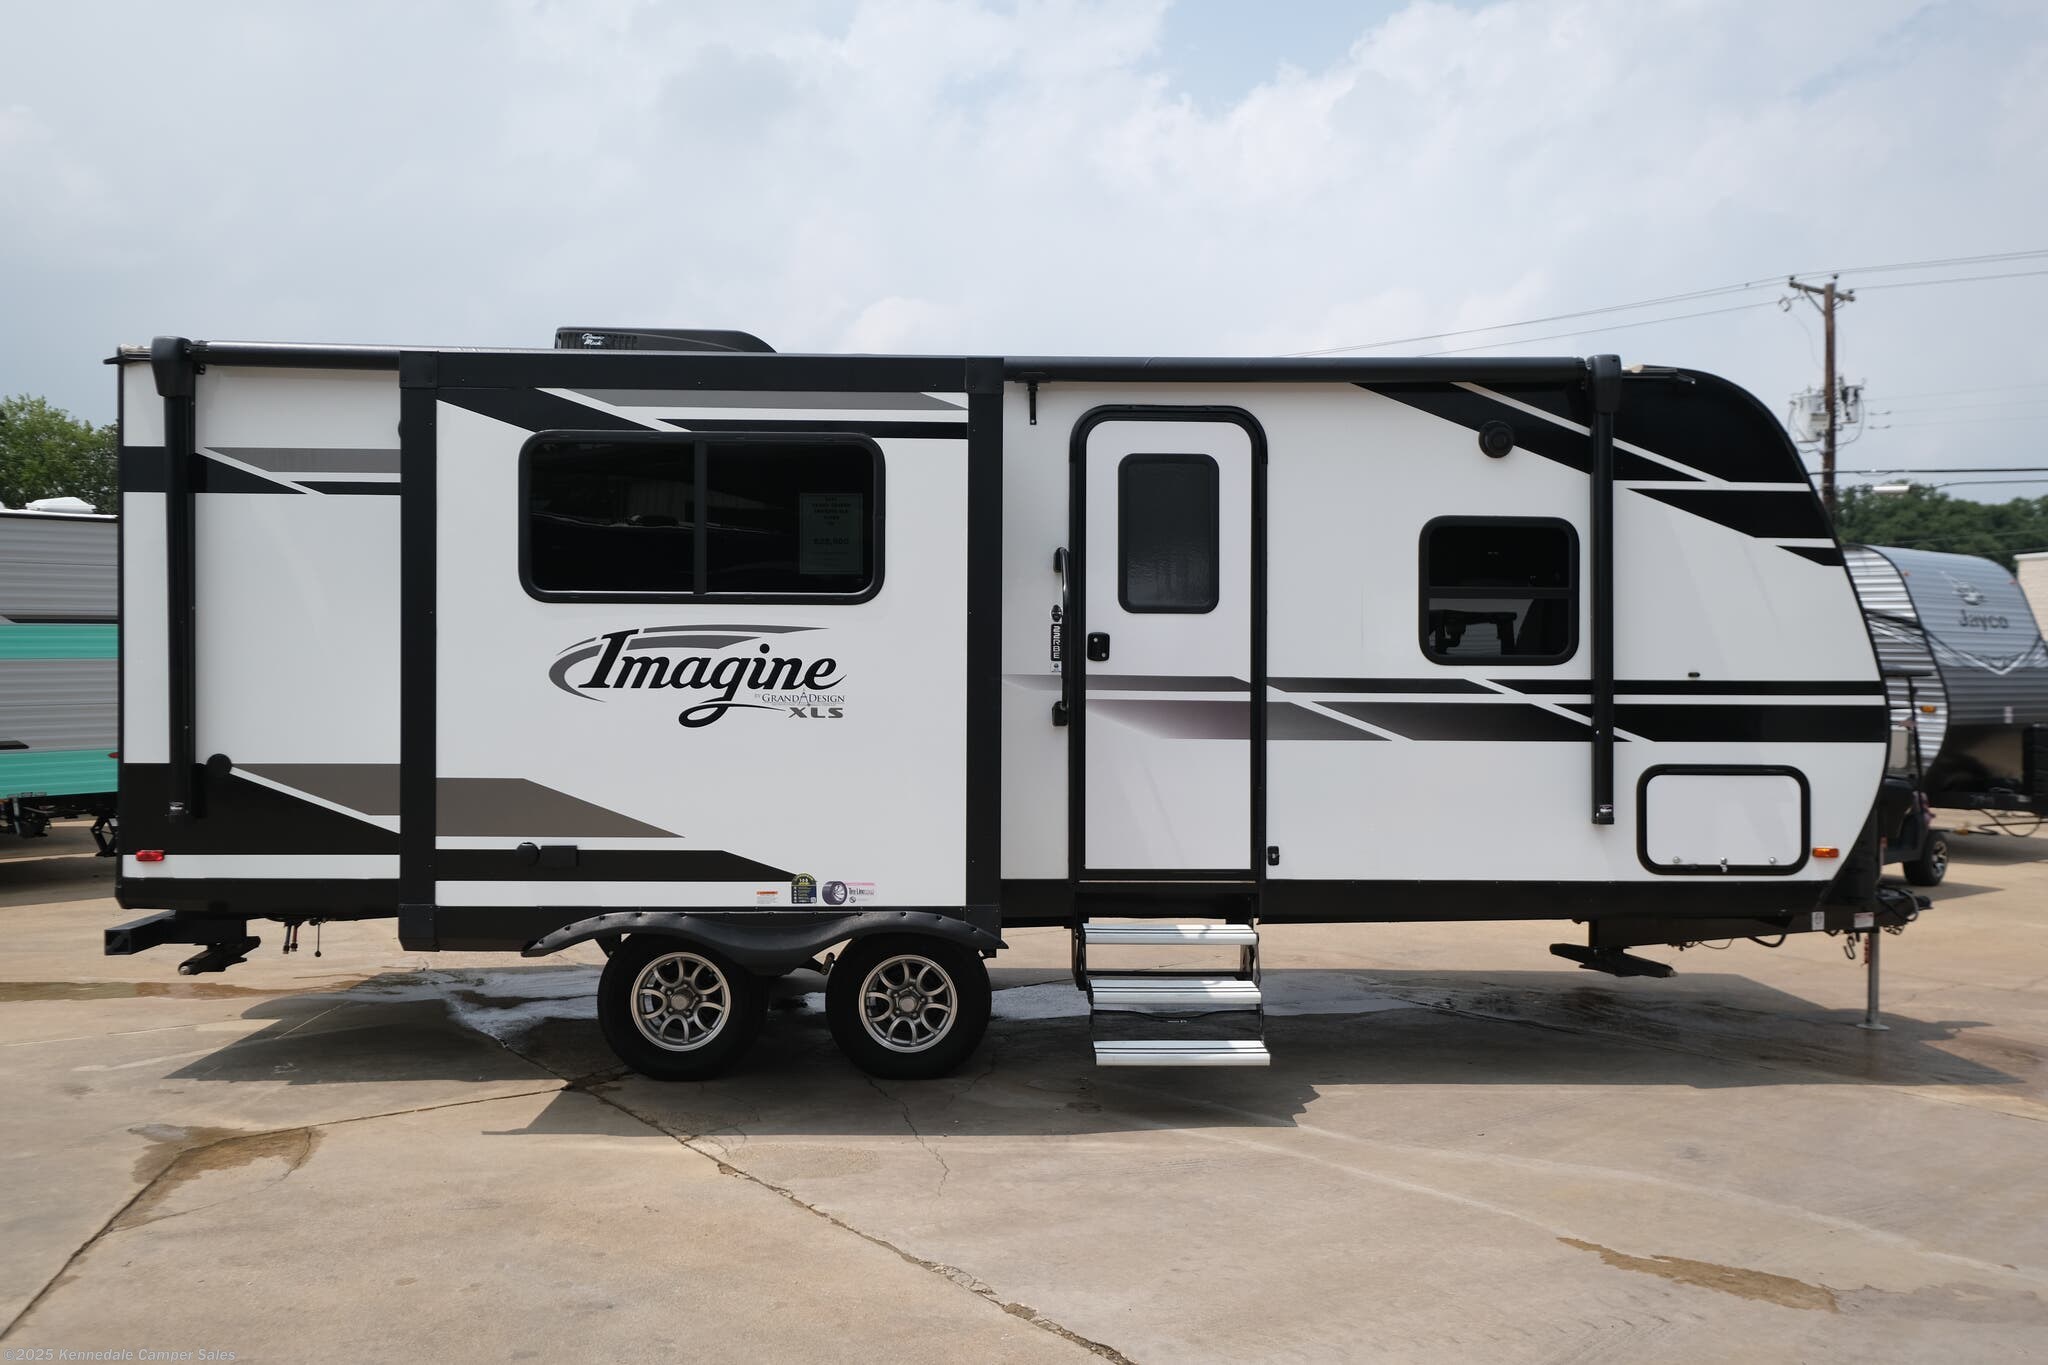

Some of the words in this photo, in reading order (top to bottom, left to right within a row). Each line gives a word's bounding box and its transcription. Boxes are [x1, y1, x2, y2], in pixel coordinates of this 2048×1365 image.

[1958, 609, 2010, 631] Jayco
[577, 628, 848, 728] Imagine
[808, 693, 845, 703] DESIGN
[788, 707, 844, 719] XLS
